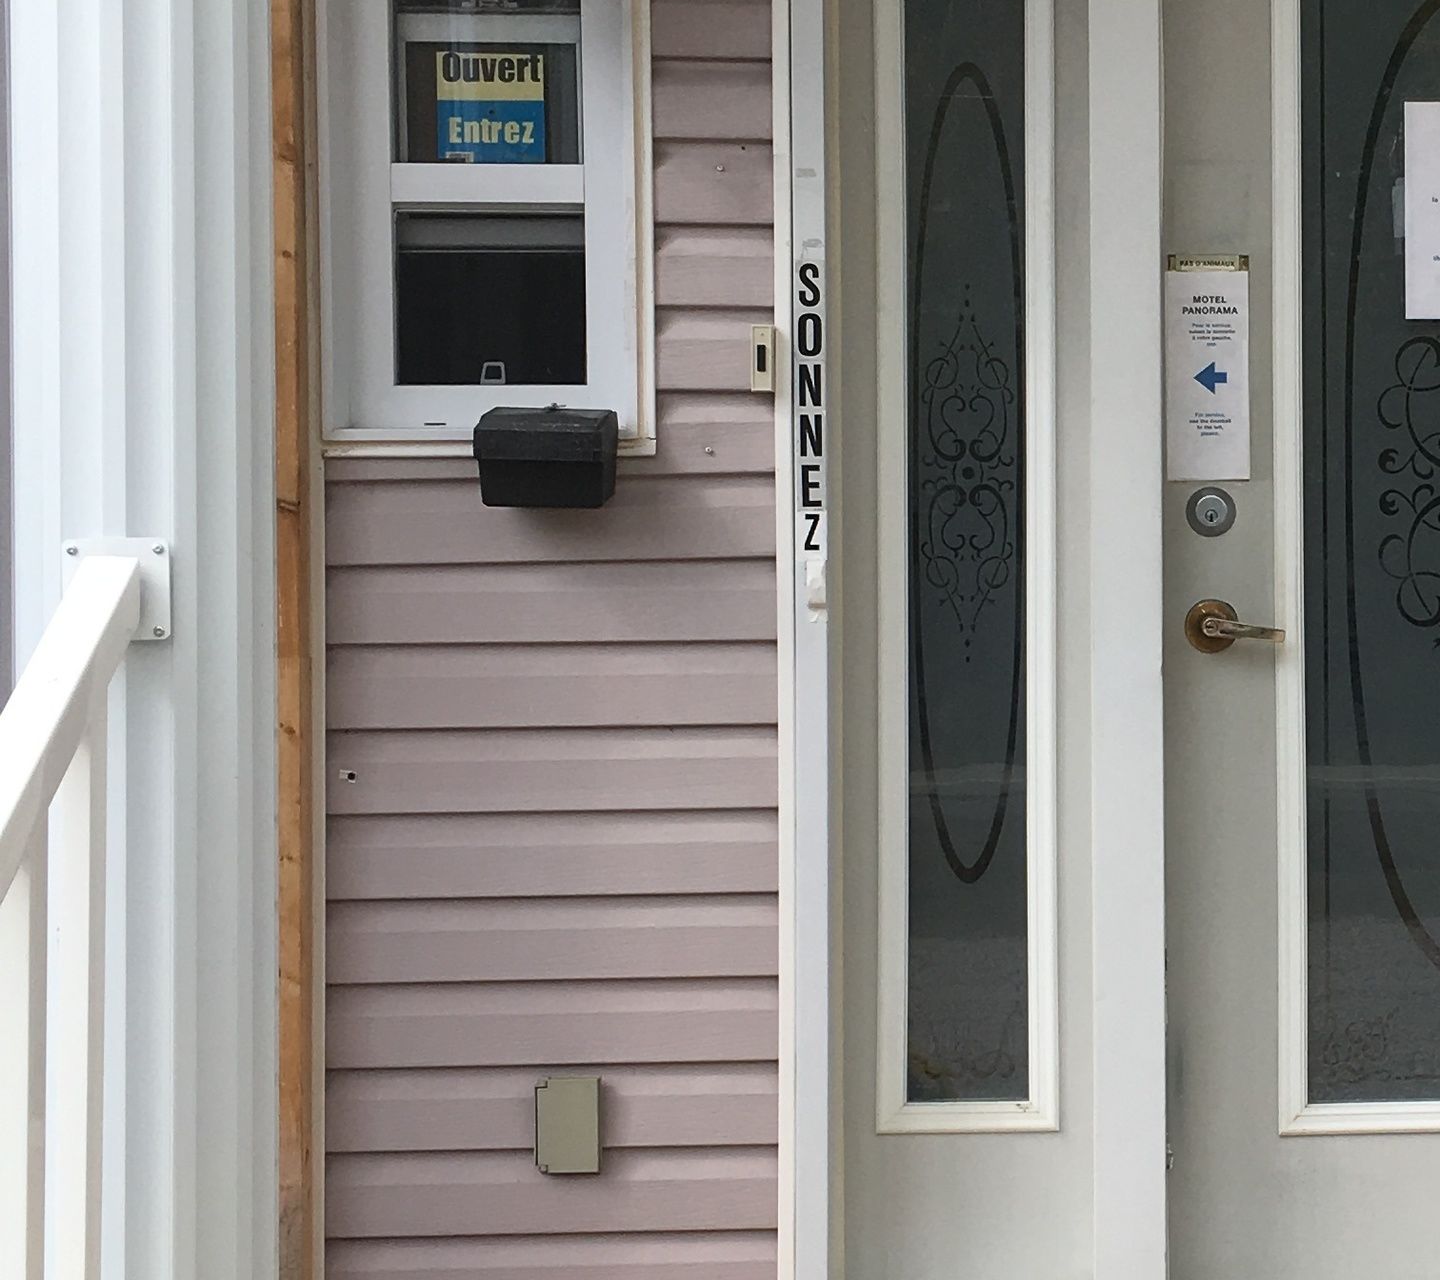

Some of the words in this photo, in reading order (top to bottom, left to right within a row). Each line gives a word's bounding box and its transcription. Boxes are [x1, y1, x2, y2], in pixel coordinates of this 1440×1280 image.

[442, 52, 541, 83] Ouvert
[449, 117, 534, 144] Entrez
[1182, 306, 1239, 314] PANORAMA
[798, 263, 823, 551] SONNEZ
